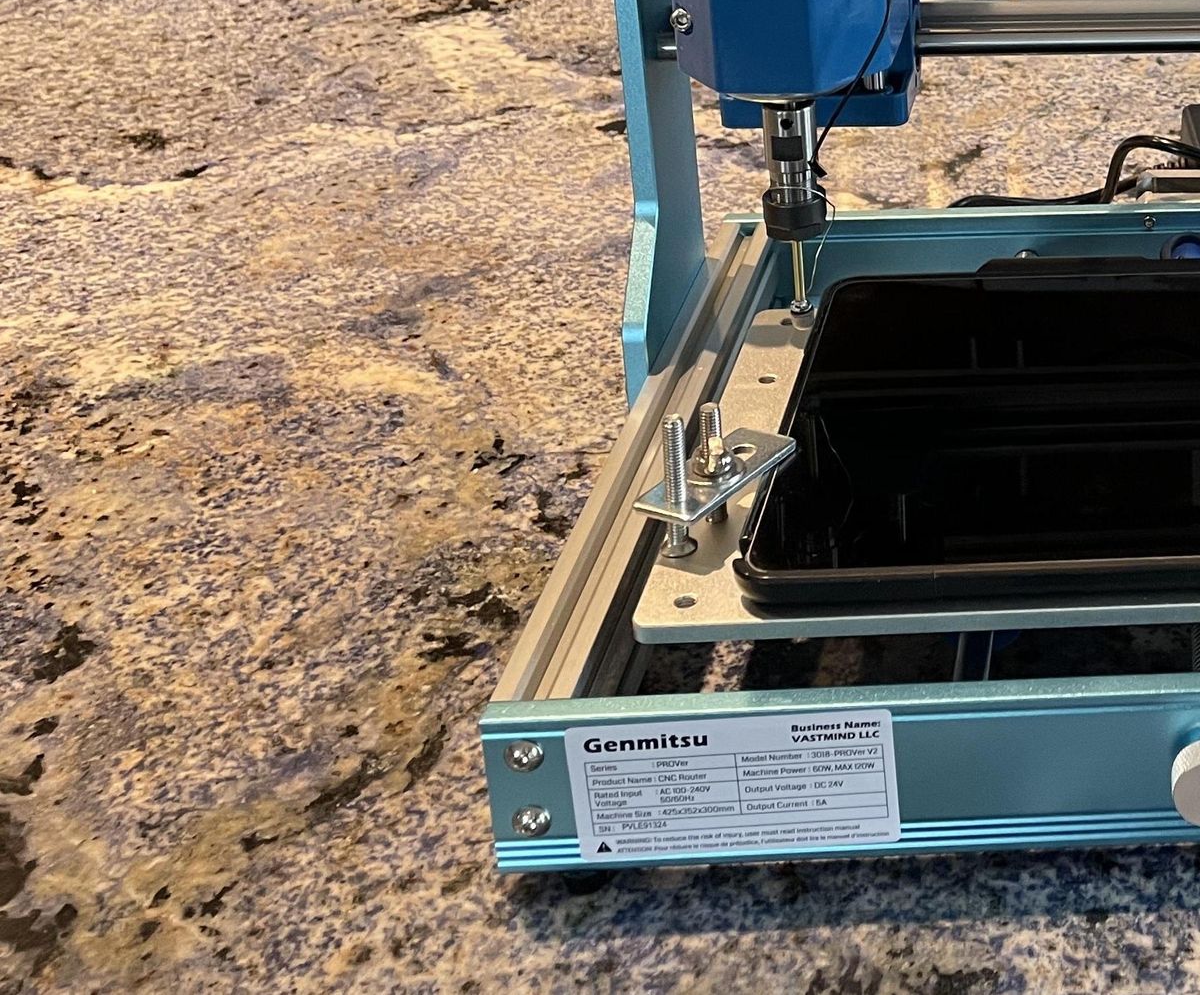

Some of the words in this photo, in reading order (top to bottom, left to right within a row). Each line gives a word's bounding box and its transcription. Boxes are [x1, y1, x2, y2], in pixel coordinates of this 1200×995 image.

[790, 723, 841, 732] Business
[792, 732, 856, 742] VASTMIND
[859, 730, 880, 738] LLC
[583, 734, 708, 753] Genmitsu
[741, 755, 767, 763] Model
[768, 753, 802, 761] Number
[743, 769, 779, 777] Machine
[592, 778, 625, 786] Product
[658, 774, 677, 782] CNC
[776, 783, 806, 791] Voltage
